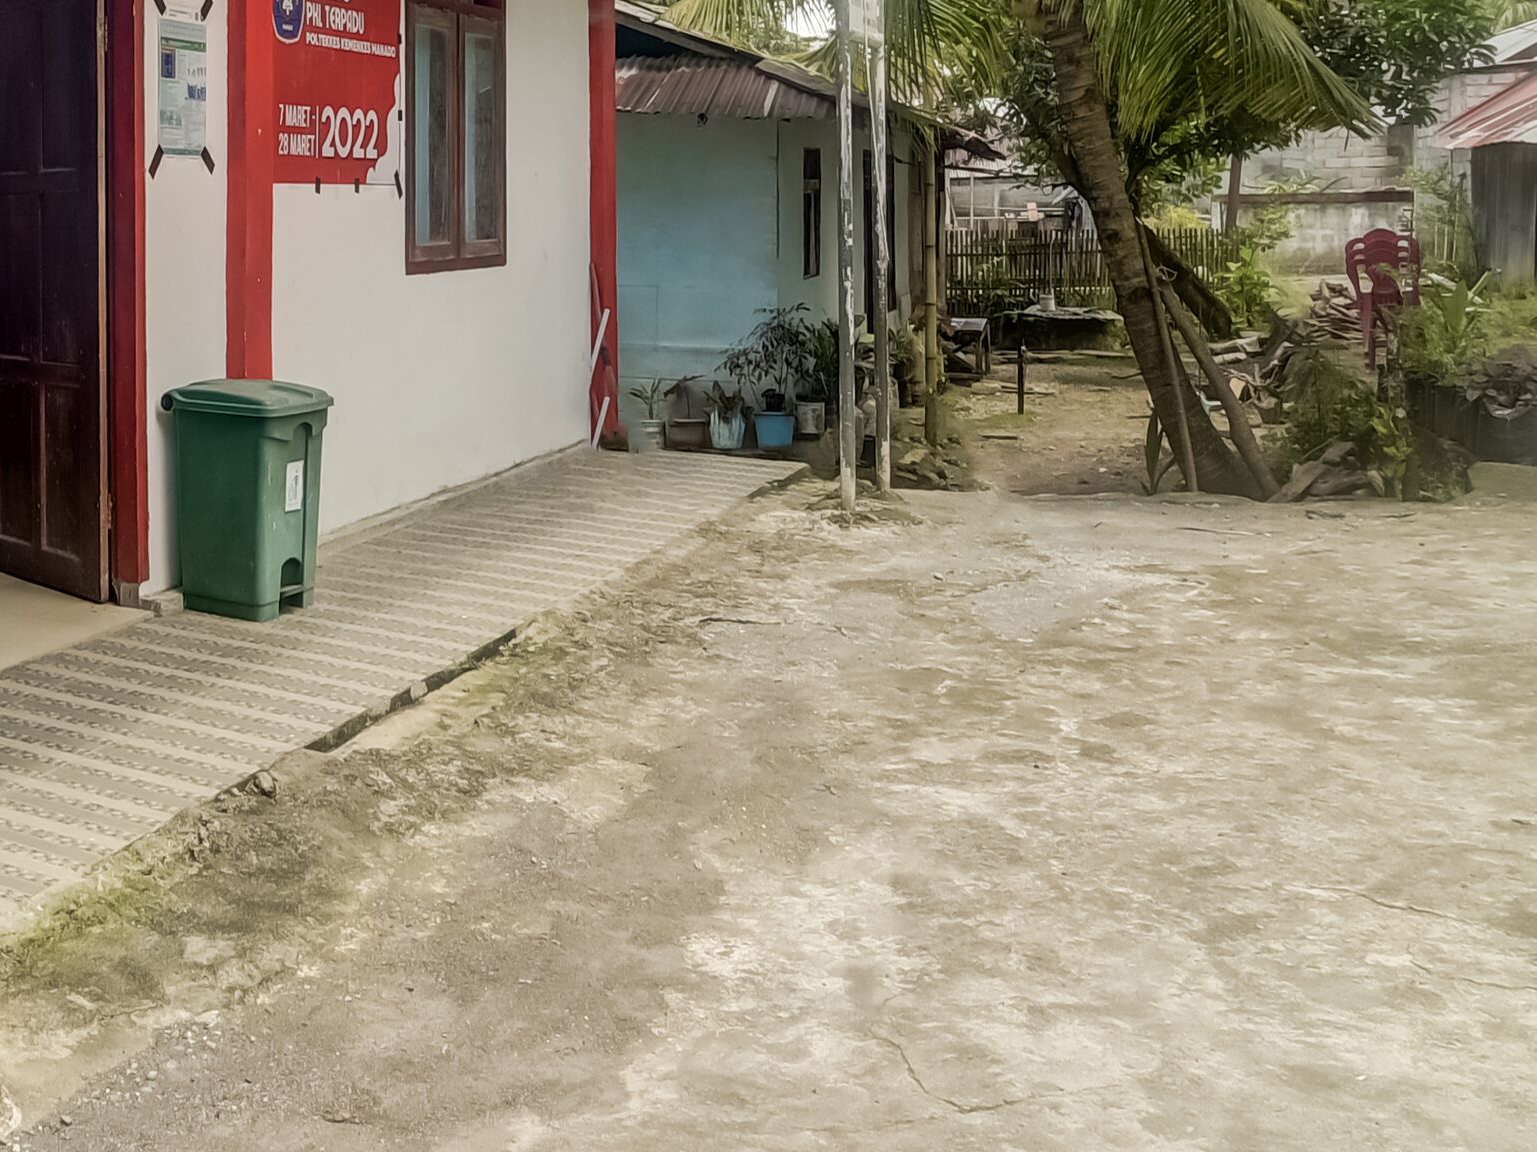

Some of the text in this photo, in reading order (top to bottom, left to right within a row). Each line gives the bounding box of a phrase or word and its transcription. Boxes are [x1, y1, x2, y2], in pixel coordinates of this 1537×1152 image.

[324, 5, 365, 34] TERPADU
[278, 103, 284, 126] 7
[285, 104, 311, 127] MARET
[278, 132, 315, 156] 28 MARET
[321, 105, 379, 159] 2022
